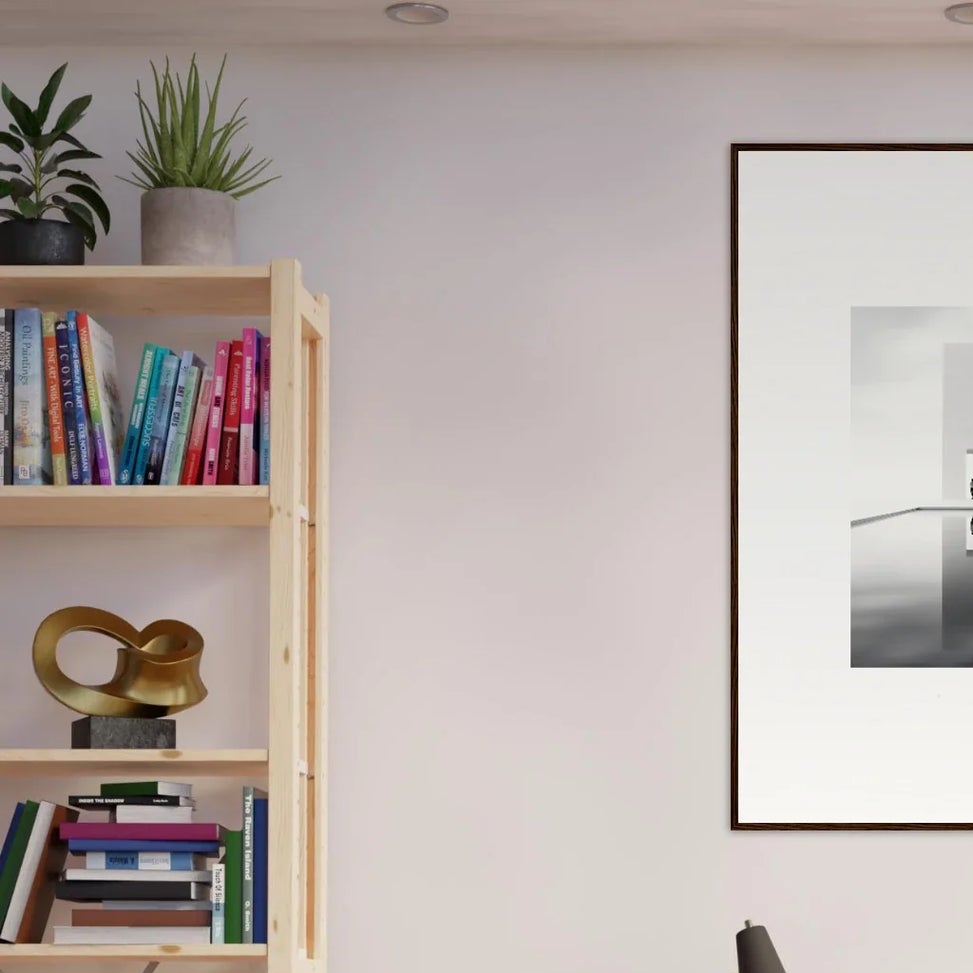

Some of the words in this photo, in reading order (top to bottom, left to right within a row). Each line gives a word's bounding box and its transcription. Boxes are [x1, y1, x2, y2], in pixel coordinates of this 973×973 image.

[21, 324, 32, 339] Oil
[46, 346, 55, 361] FINE
[70, 343, 79, 359] Find
[18, 341, 32, 386] Paintings
[47, 360, 56, 379] ART
[71, 358, 81, 384] Beauty
[79, 327, 93, 374] Watercolor
[86, 374, 99, 411] Portraits
[58, 343, 73, 408] ICONIC
[231, 363, 240, 397] Parenting
[49, 383, 58, 401] With
[74, 393, 83, 408] ART
[48, 401, 61, 424] Digital
[229, 397, 238, 416] Skills
[52, 424, 62, 442] Tools
[78, 438, 88, 472] NORMAN
[244, 795, 252, 814] The
[244, 816, 252, 847] Raven
[244, 849, 252, 881] Island
[214, 868, 223, 885] Touch
